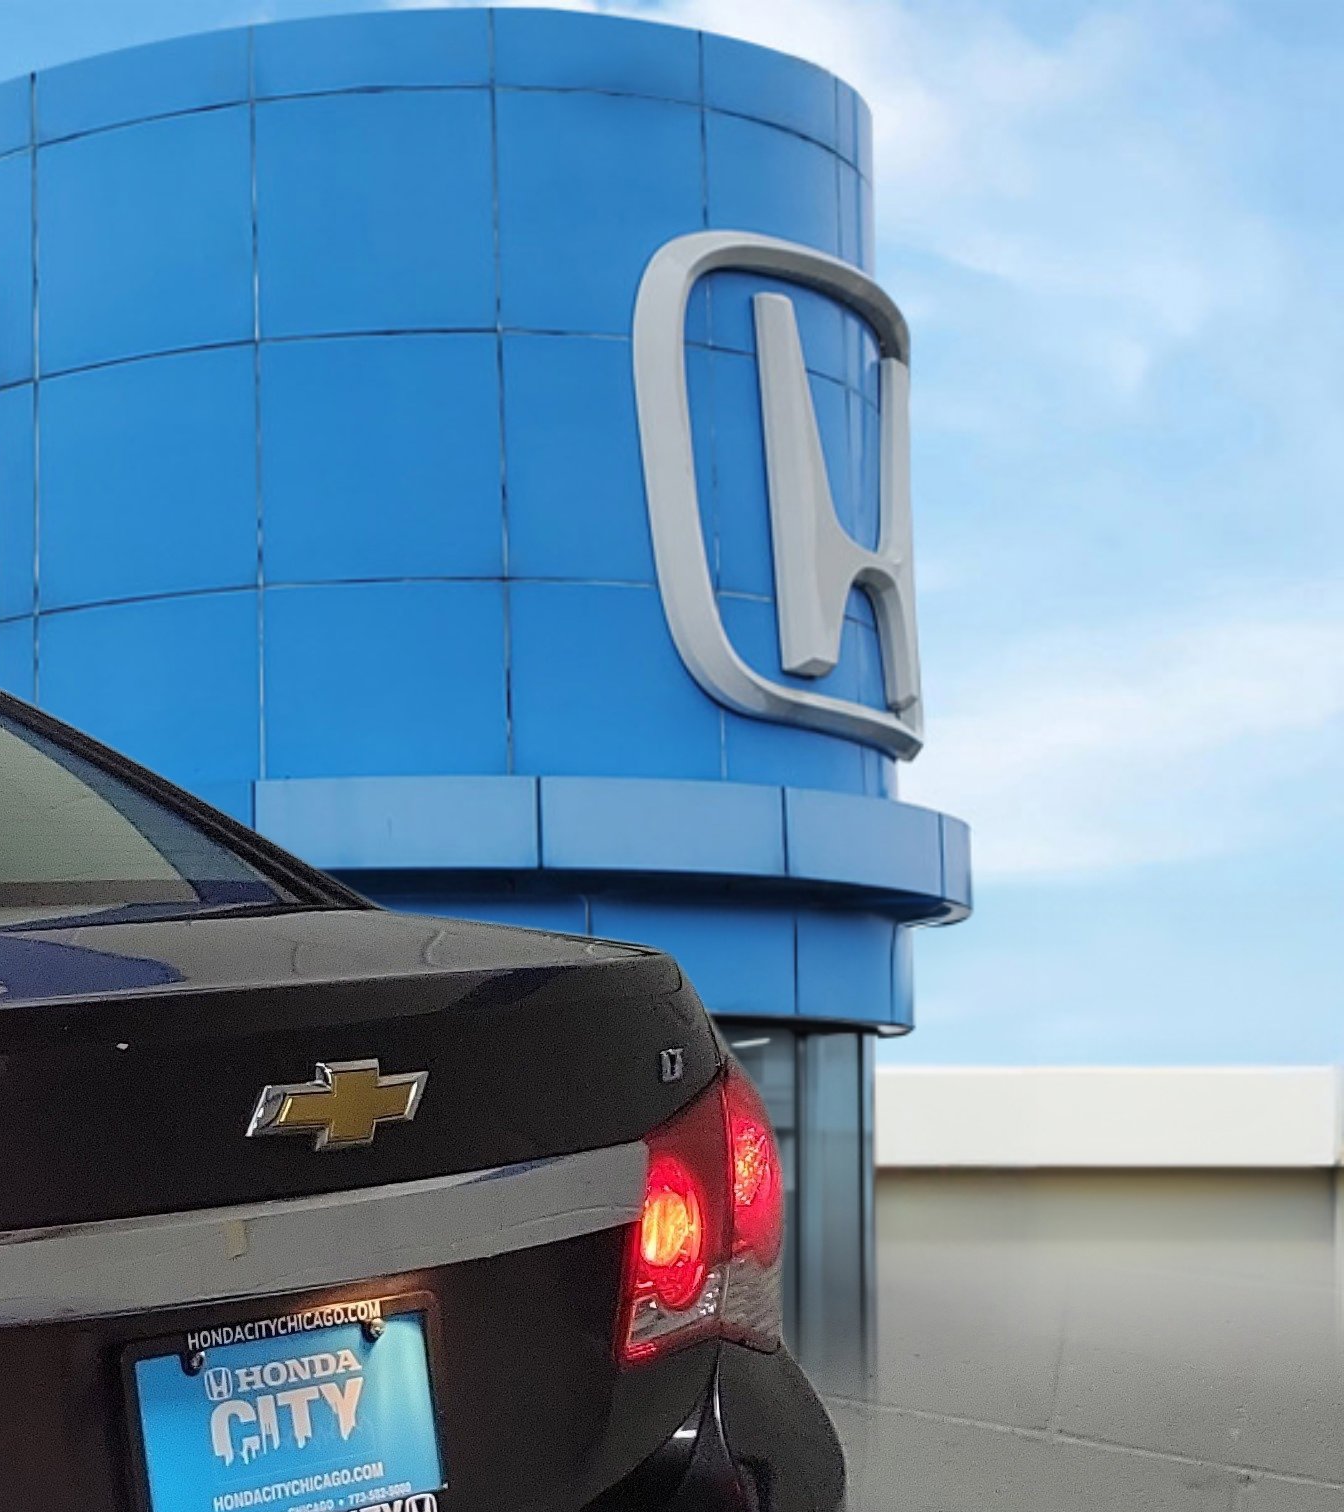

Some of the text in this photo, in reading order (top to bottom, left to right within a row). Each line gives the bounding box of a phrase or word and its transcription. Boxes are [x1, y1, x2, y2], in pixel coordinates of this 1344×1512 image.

[187, 1301, 383, 1350] HONDACITYCHICAGO.COM
[235, 1349, 363, 1393] HONDA
[210, 1376, 364, 1467] CITY
[213, 1462, 385, 1512] HONDACITYCHICAGO.COM
